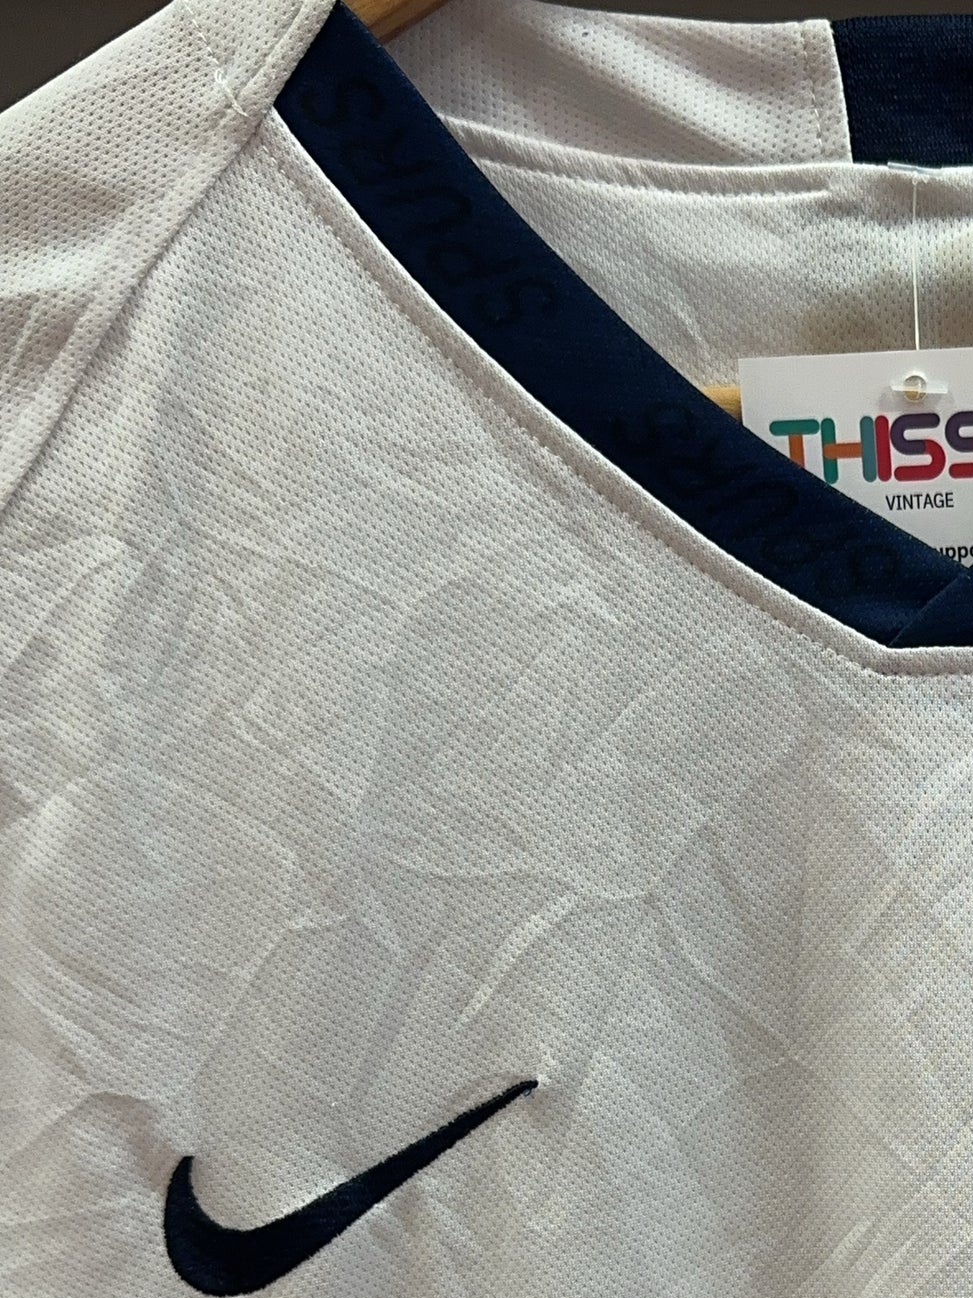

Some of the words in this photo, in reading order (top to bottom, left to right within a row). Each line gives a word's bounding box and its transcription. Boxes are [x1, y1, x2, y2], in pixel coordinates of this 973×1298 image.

[300, 77, 561, 330] SPURS
[610, 402, 902, 597] SPURS
[886, 492, 954, 511] VINTAGE
